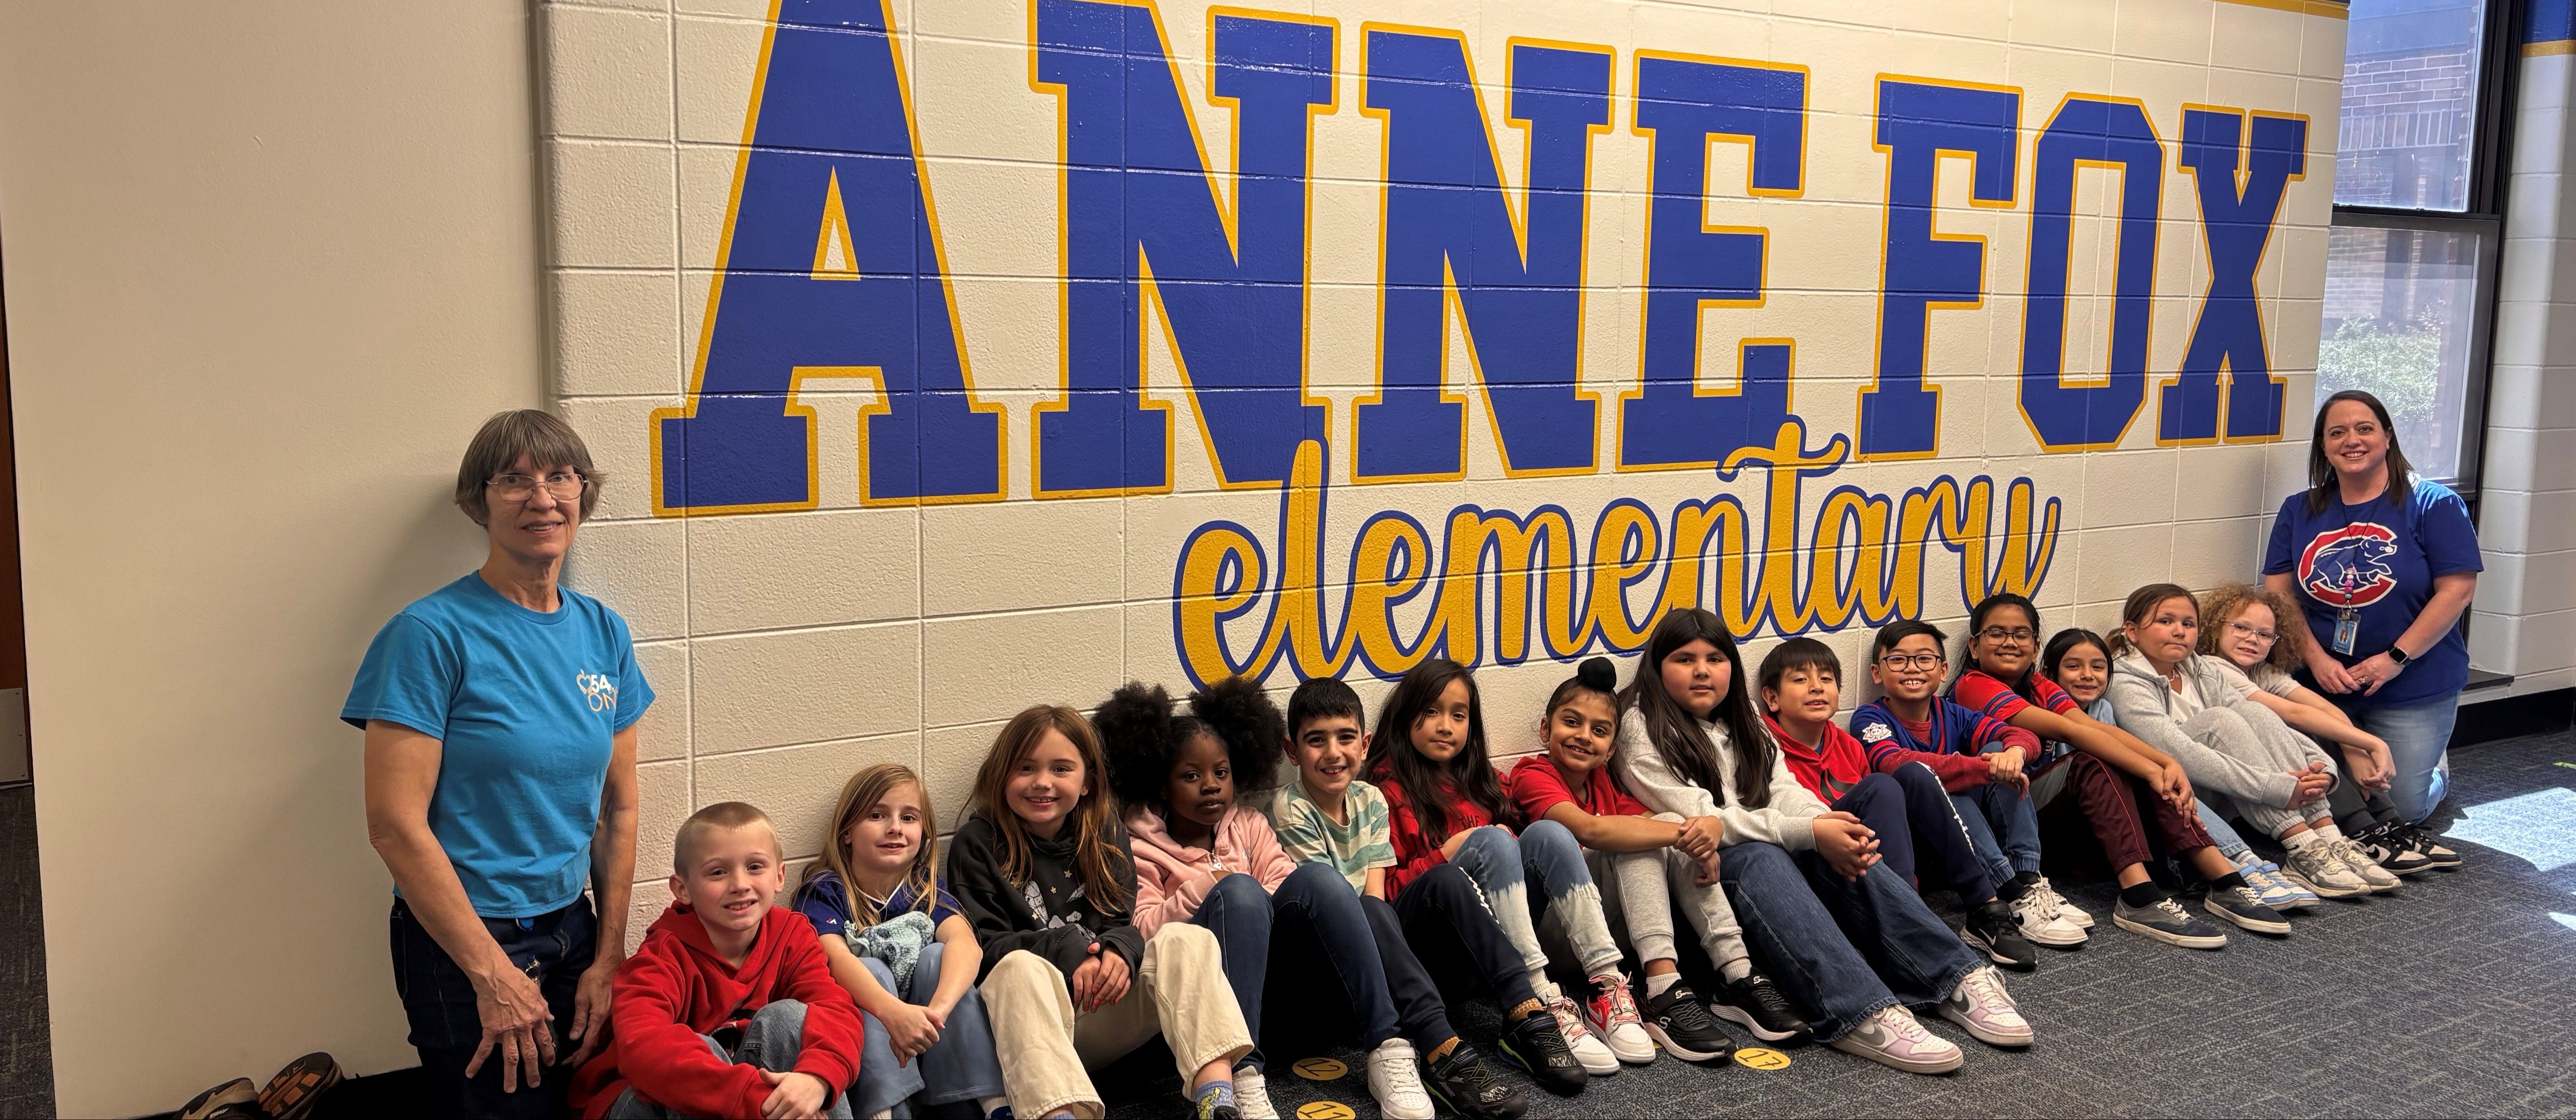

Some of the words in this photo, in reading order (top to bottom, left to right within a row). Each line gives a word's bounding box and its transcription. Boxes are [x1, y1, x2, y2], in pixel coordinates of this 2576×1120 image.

[650, 0, 1810, 516] ANNE
[1853, 72, 2311, 462] FOX
[1173, 415, 2061, 694] elementary
[1297, 1059, 1341, 1077] 12
[1738, 1050, 1783, 1067] 17
